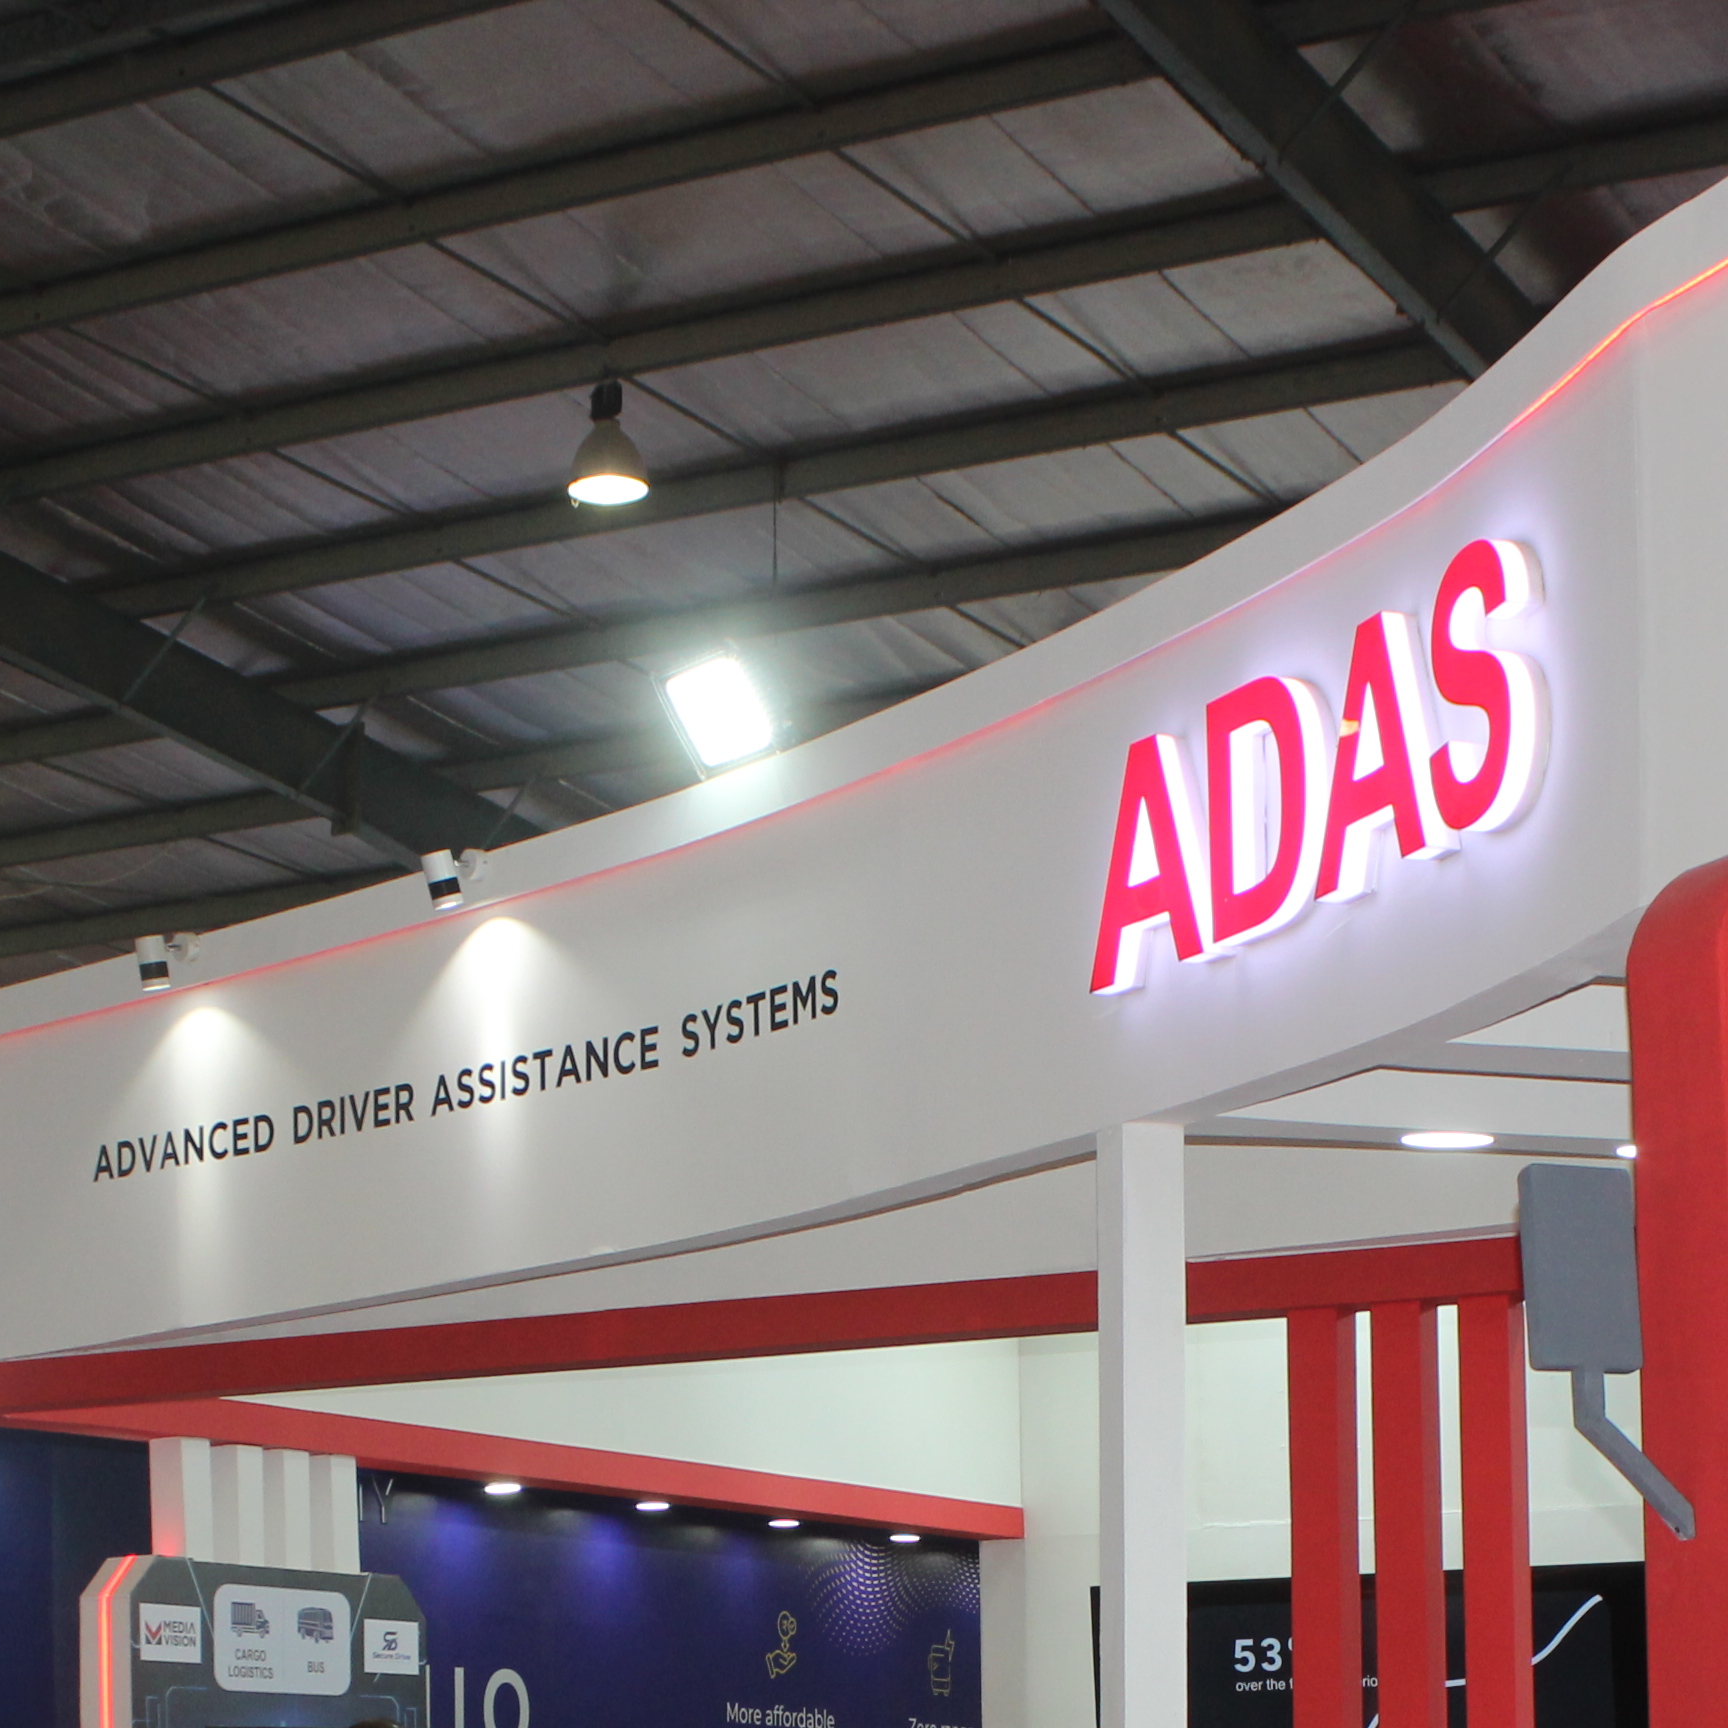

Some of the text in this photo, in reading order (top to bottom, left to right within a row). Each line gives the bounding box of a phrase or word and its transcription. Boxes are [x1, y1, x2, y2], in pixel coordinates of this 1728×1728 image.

[1090, 539, 1522, 994] ADAS
[94, 969, 839, 1182] ADVANCED DRIVER ASSISTANCE SYSTEMS
[163, 1620, 196, 1634] MEDIA
[163, 1634, 196, 1648] VISION
[234, 1648, 267, 1663] CARGO
[228, 1664, 274, 1680] LOGISTICS
[307, 1661, 325, 1675] BUS
[1235, 1681, 1263, 1692] over
[1266, 1678, 1286, 1690] the
[726, 1702, 762, 1725] More
